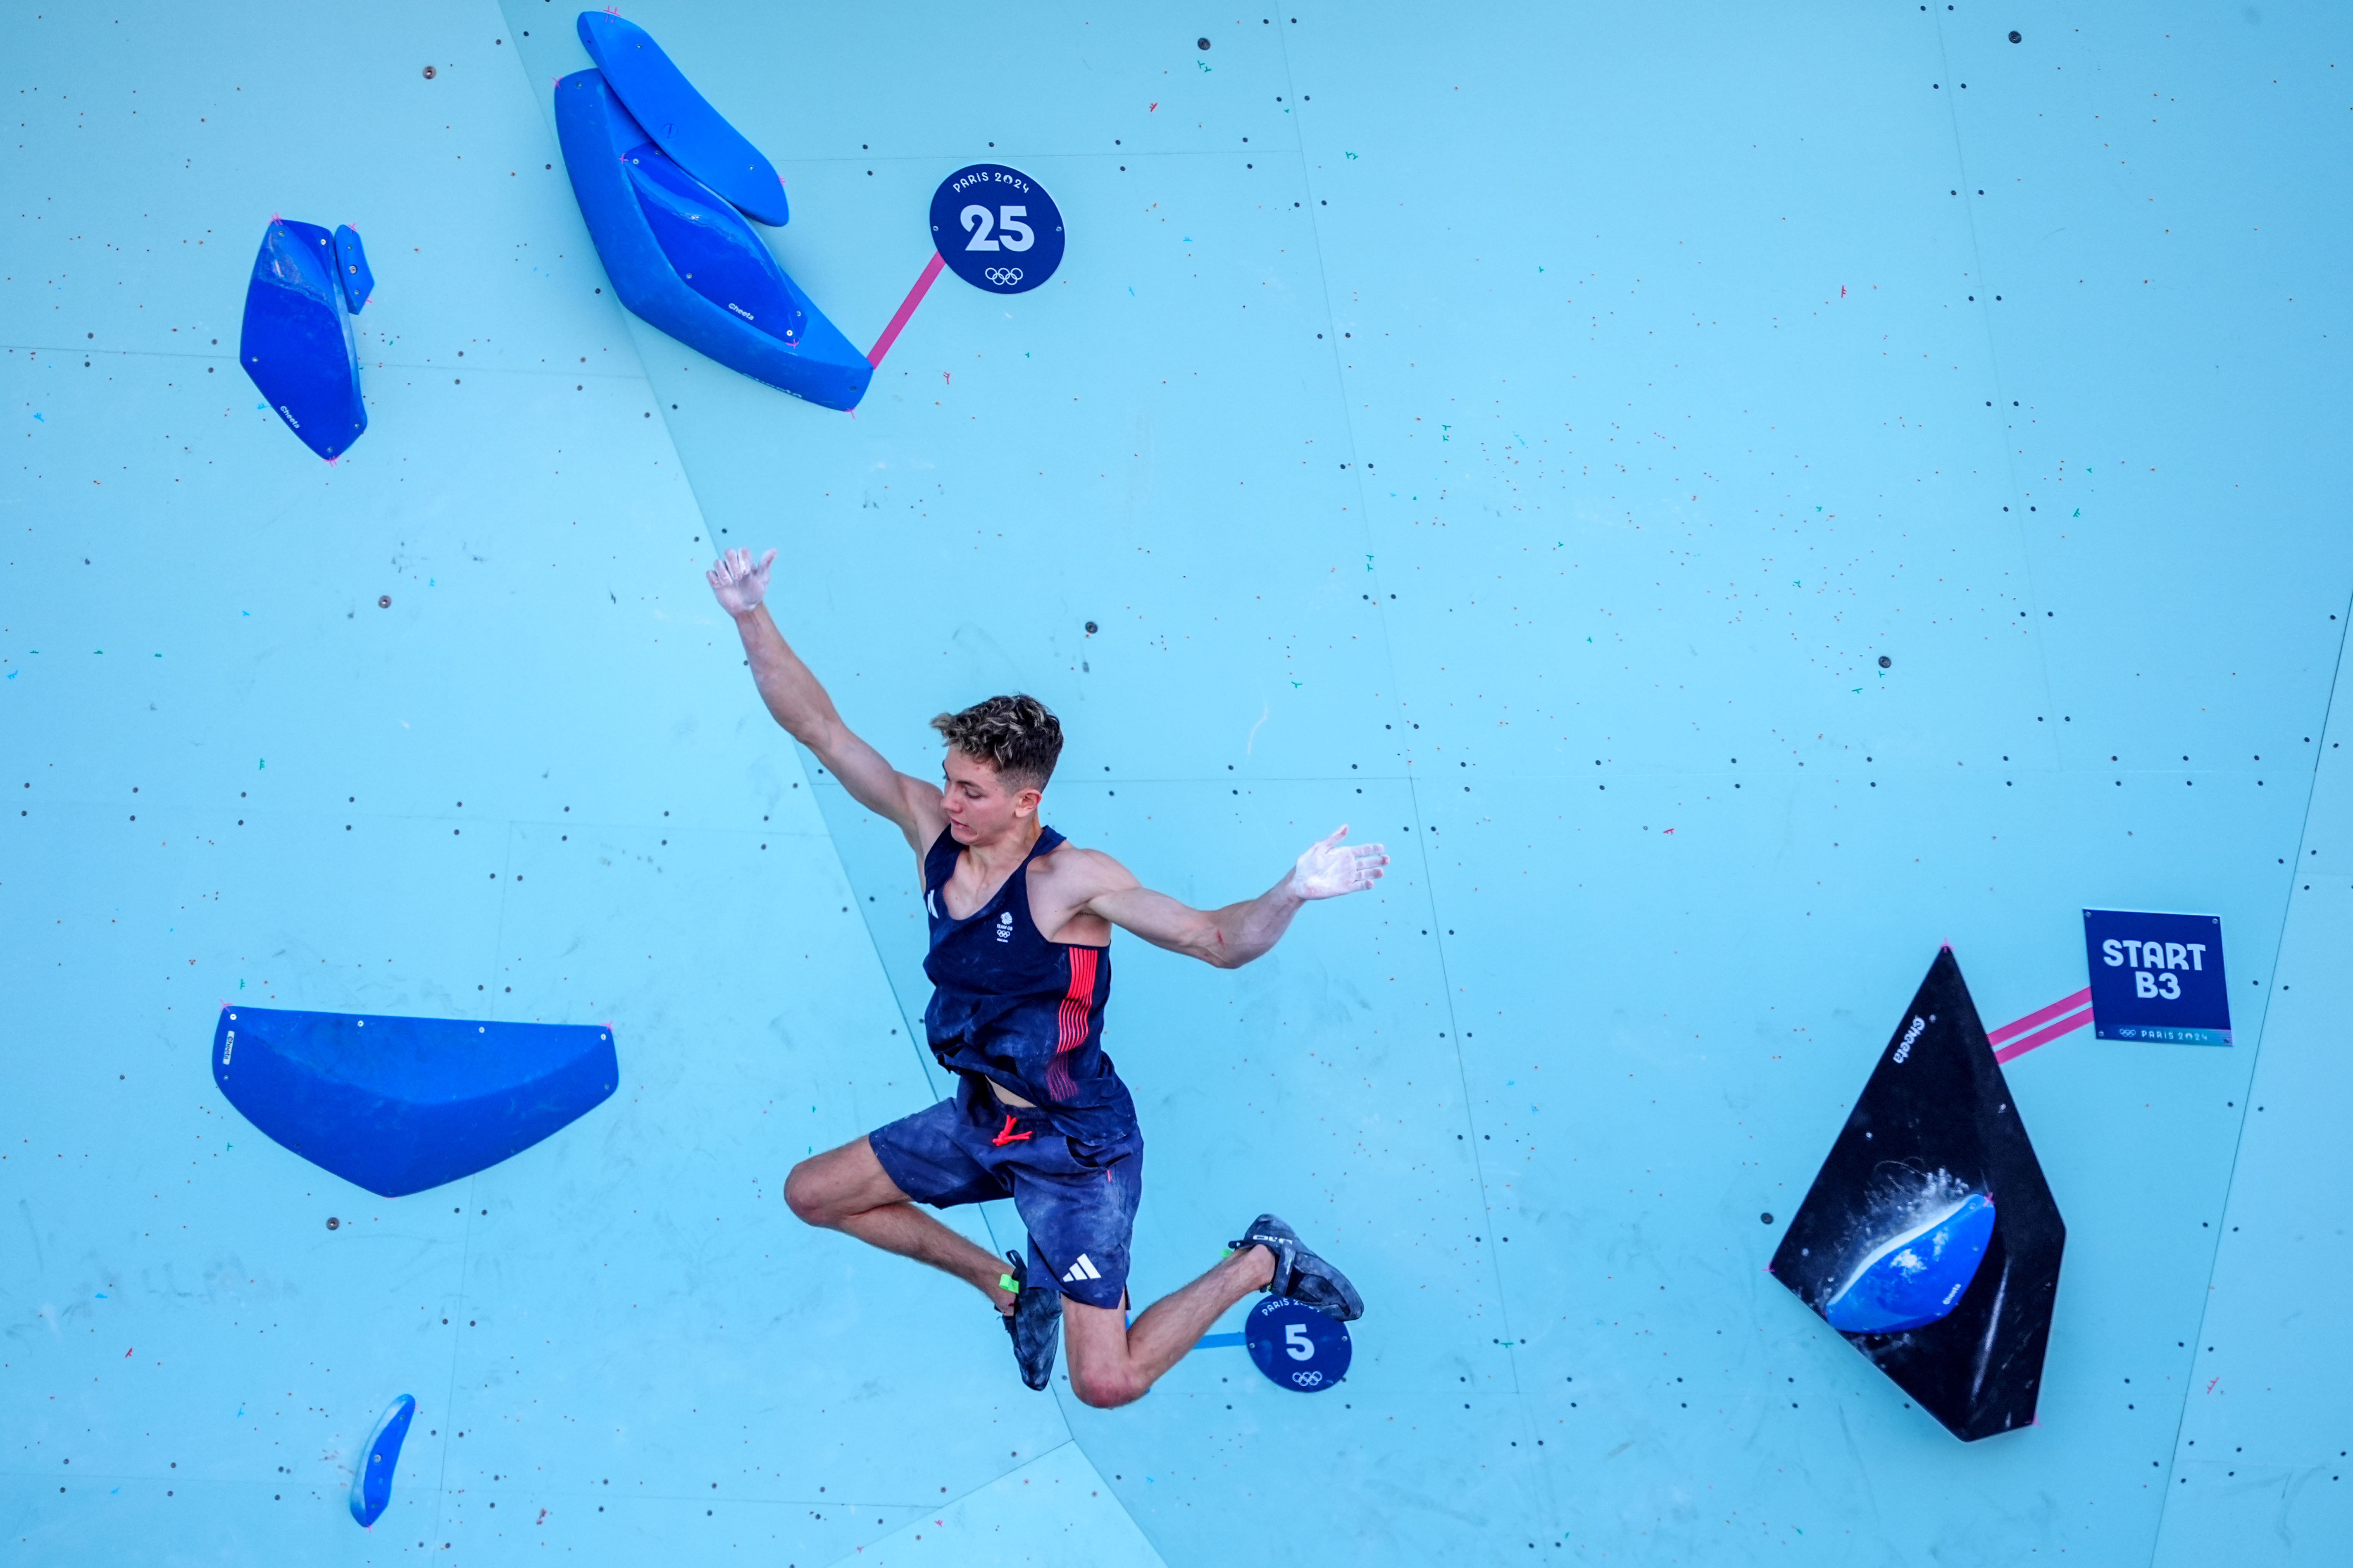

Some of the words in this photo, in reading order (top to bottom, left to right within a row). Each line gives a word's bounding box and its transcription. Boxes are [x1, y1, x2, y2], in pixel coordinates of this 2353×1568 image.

[953, 172, 989, 193] PARIS
[995, 172, 1029, 193] 2024
[960, 204, 1035, 252] 25
[729, 303, 754, 320] Cheeta
[280, 406, 300, 429] Cheeta
[2103, 939, 2206, 971] START
[2135, 971, 2182, 1000] B3
[1893, 1016, 1925, 1063] Cheeta
[2141, 1030, 2174, 1039] PARIS
[2178, 1032, 2208, 1041] 2024
[224, 1036, 233, 1060] Cheeta
[1262, 1297, 1290, 1316] PARIS
[1285, 1324, 1315, 1361] 5
